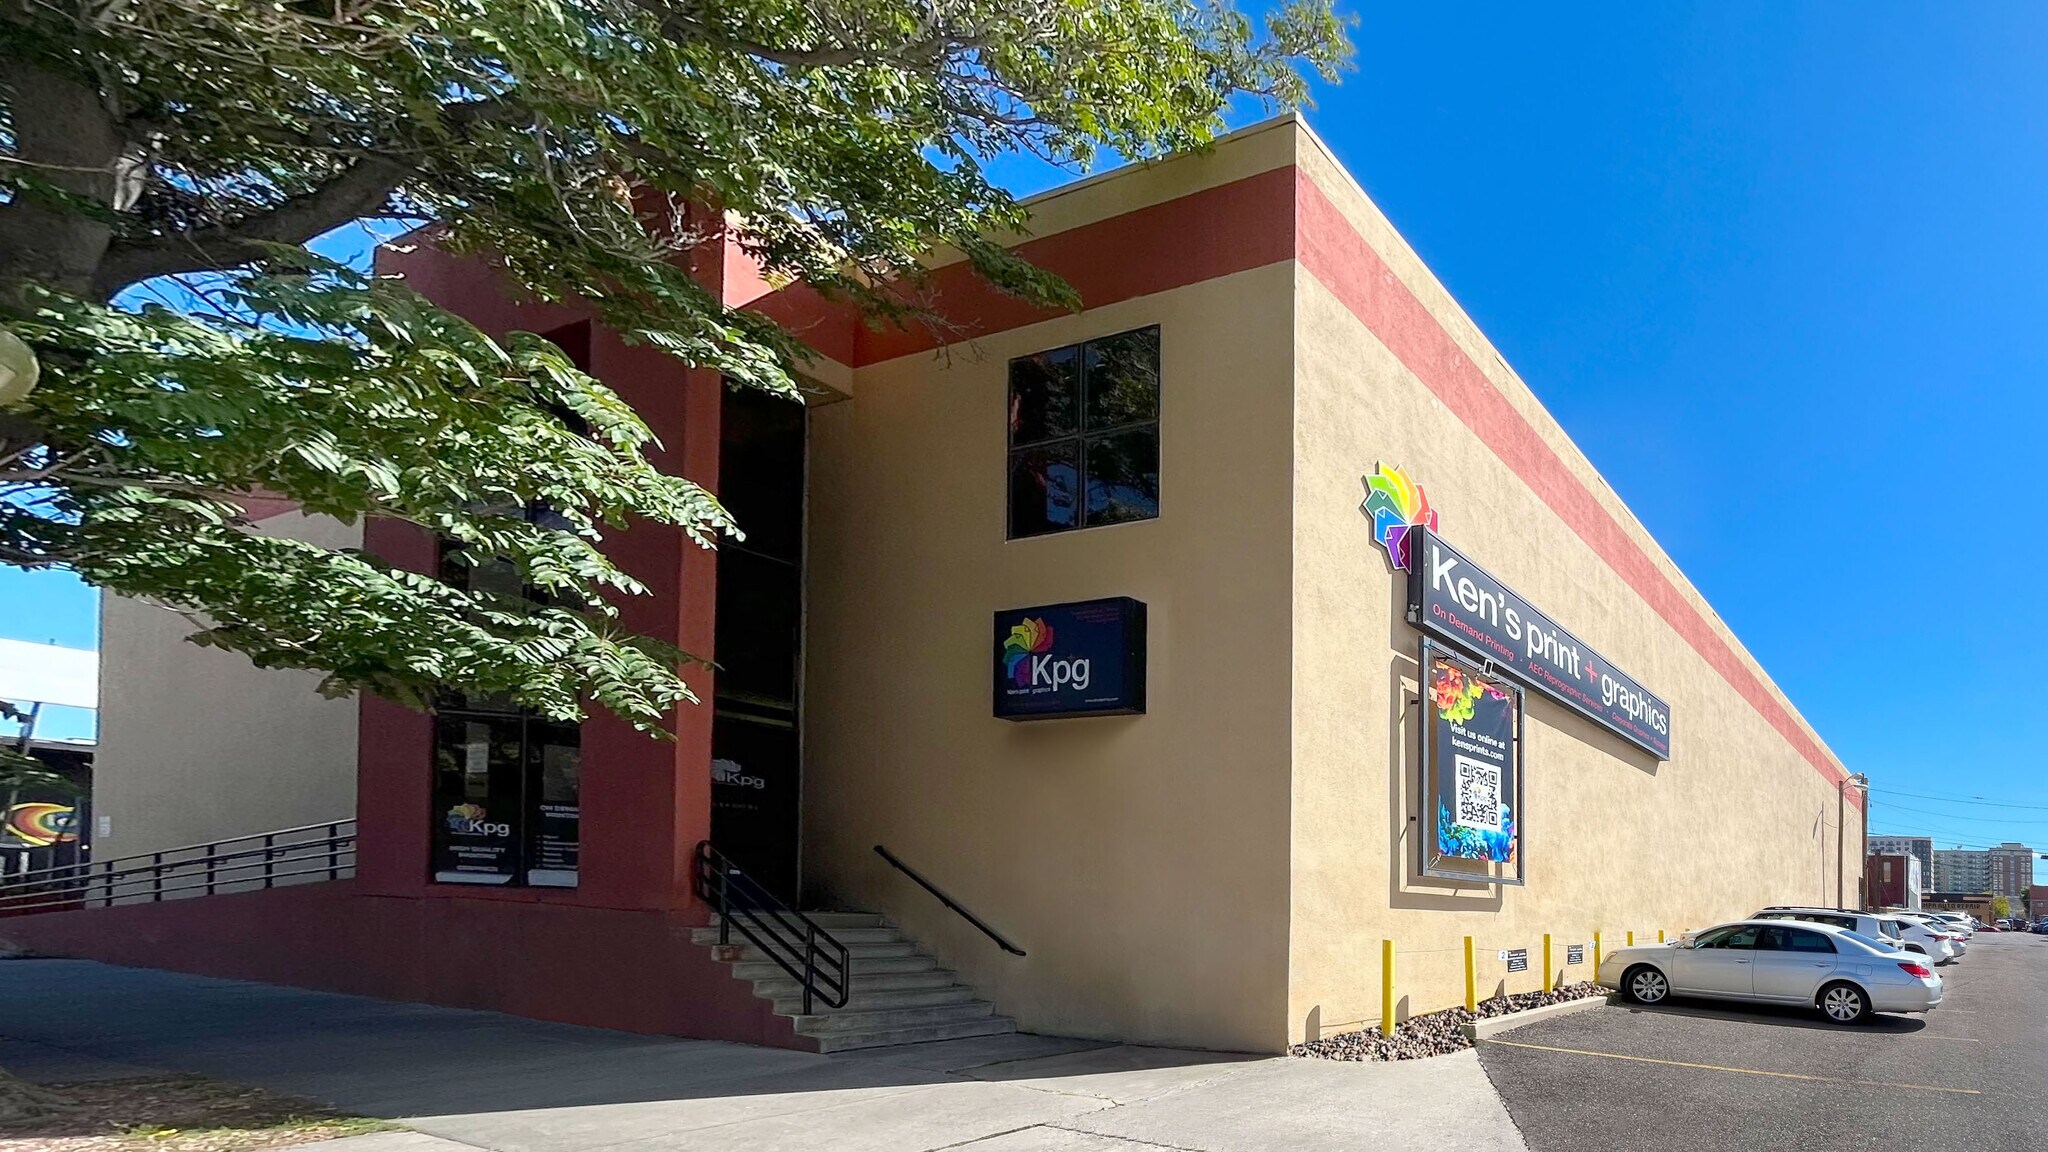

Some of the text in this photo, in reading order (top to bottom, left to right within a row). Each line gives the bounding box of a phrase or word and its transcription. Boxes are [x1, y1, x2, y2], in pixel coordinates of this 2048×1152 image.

[1432, 603, 1515, 662] On Demand Printing
[1432, 544, 1522, 641] Ken's
[1526, 620, 1581, 680] print
[1601, 673, 1667, 736] graphics
[1031, 653, 1090, 692] Kpg
[1528, 661, 1604, 713] AEC Reprographic Services
[1450, 721, 1506, 750] Visit us online at
[1451, 735, 1505, 761] kensprints.com
[726, 771, 765, 789] Kpg
[469, 819, 510, 837] Kpg
